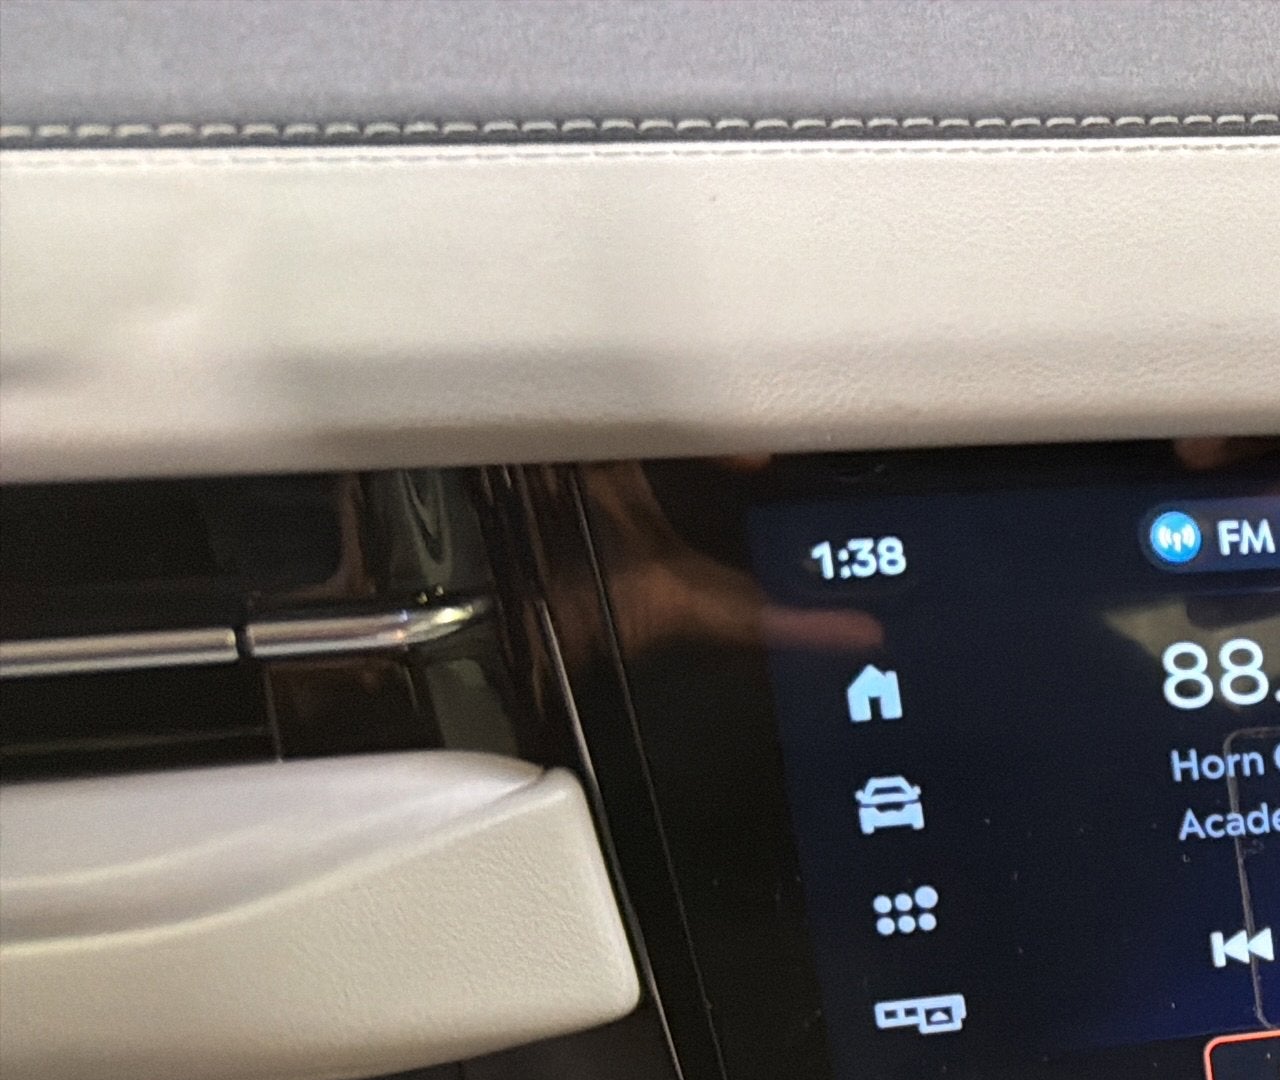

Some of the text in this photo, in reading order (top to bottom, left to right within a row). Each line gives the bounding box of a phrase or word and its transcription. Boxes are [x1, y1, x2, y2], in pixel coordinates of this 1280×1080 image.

[1218, 518, 1276, 557] FM
[811, 536, 906, 581] 1:38
[1171, 746, 1265, 782] Horn
